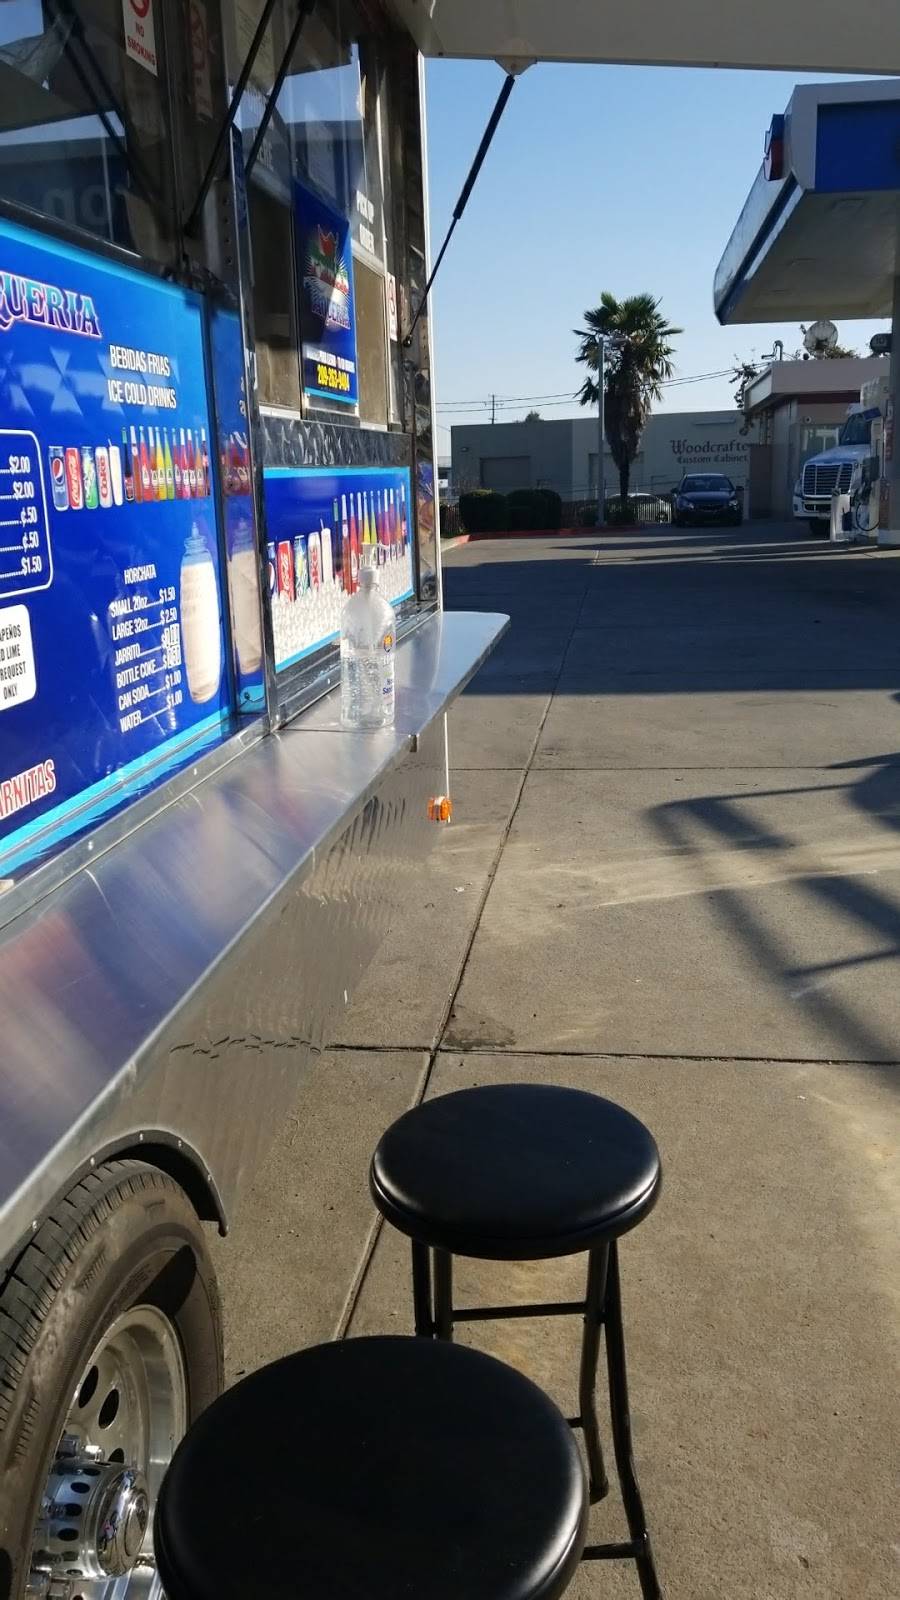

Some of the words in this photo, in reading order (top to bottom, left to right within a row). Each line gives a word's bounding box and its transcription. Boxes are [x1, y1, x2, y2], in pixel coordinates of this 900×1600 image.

[135, 22, 145, 38] NO
[127, 35, 156, 66] SMOKING
[0, 271, 102, 338] UERIA
[109, 344, 147, 373] BEBIDAS
[147, 352, 171, 376] FRIAS
[107, 379, 123, 403] ICE
[124, 381, 146, 406] COLD
[148, 385, 177, 409] DRINKS
[677, 455, 711, 464] Custom
[124, 564, 157, 585] HORCHATA
[111, 597, 133, 618] SMALL
[112, 620, 134, 641] LARGE
[6, 644, 21, 660] LIME
[115, 643, 141, 666] JARRITO
[0, 661, 26, 681] REQUEST
[116, 665, 140, 688] BOTTLE
[140, 659, 156, 679] COKE
[3, 683, 18, 700] ONLY
[118, 691, 133, 711] CAN
[132, 684, 150, 704] SODA
[119, 710, 142, 733] WATER
[0, 759, 56, 820] RNITAS
